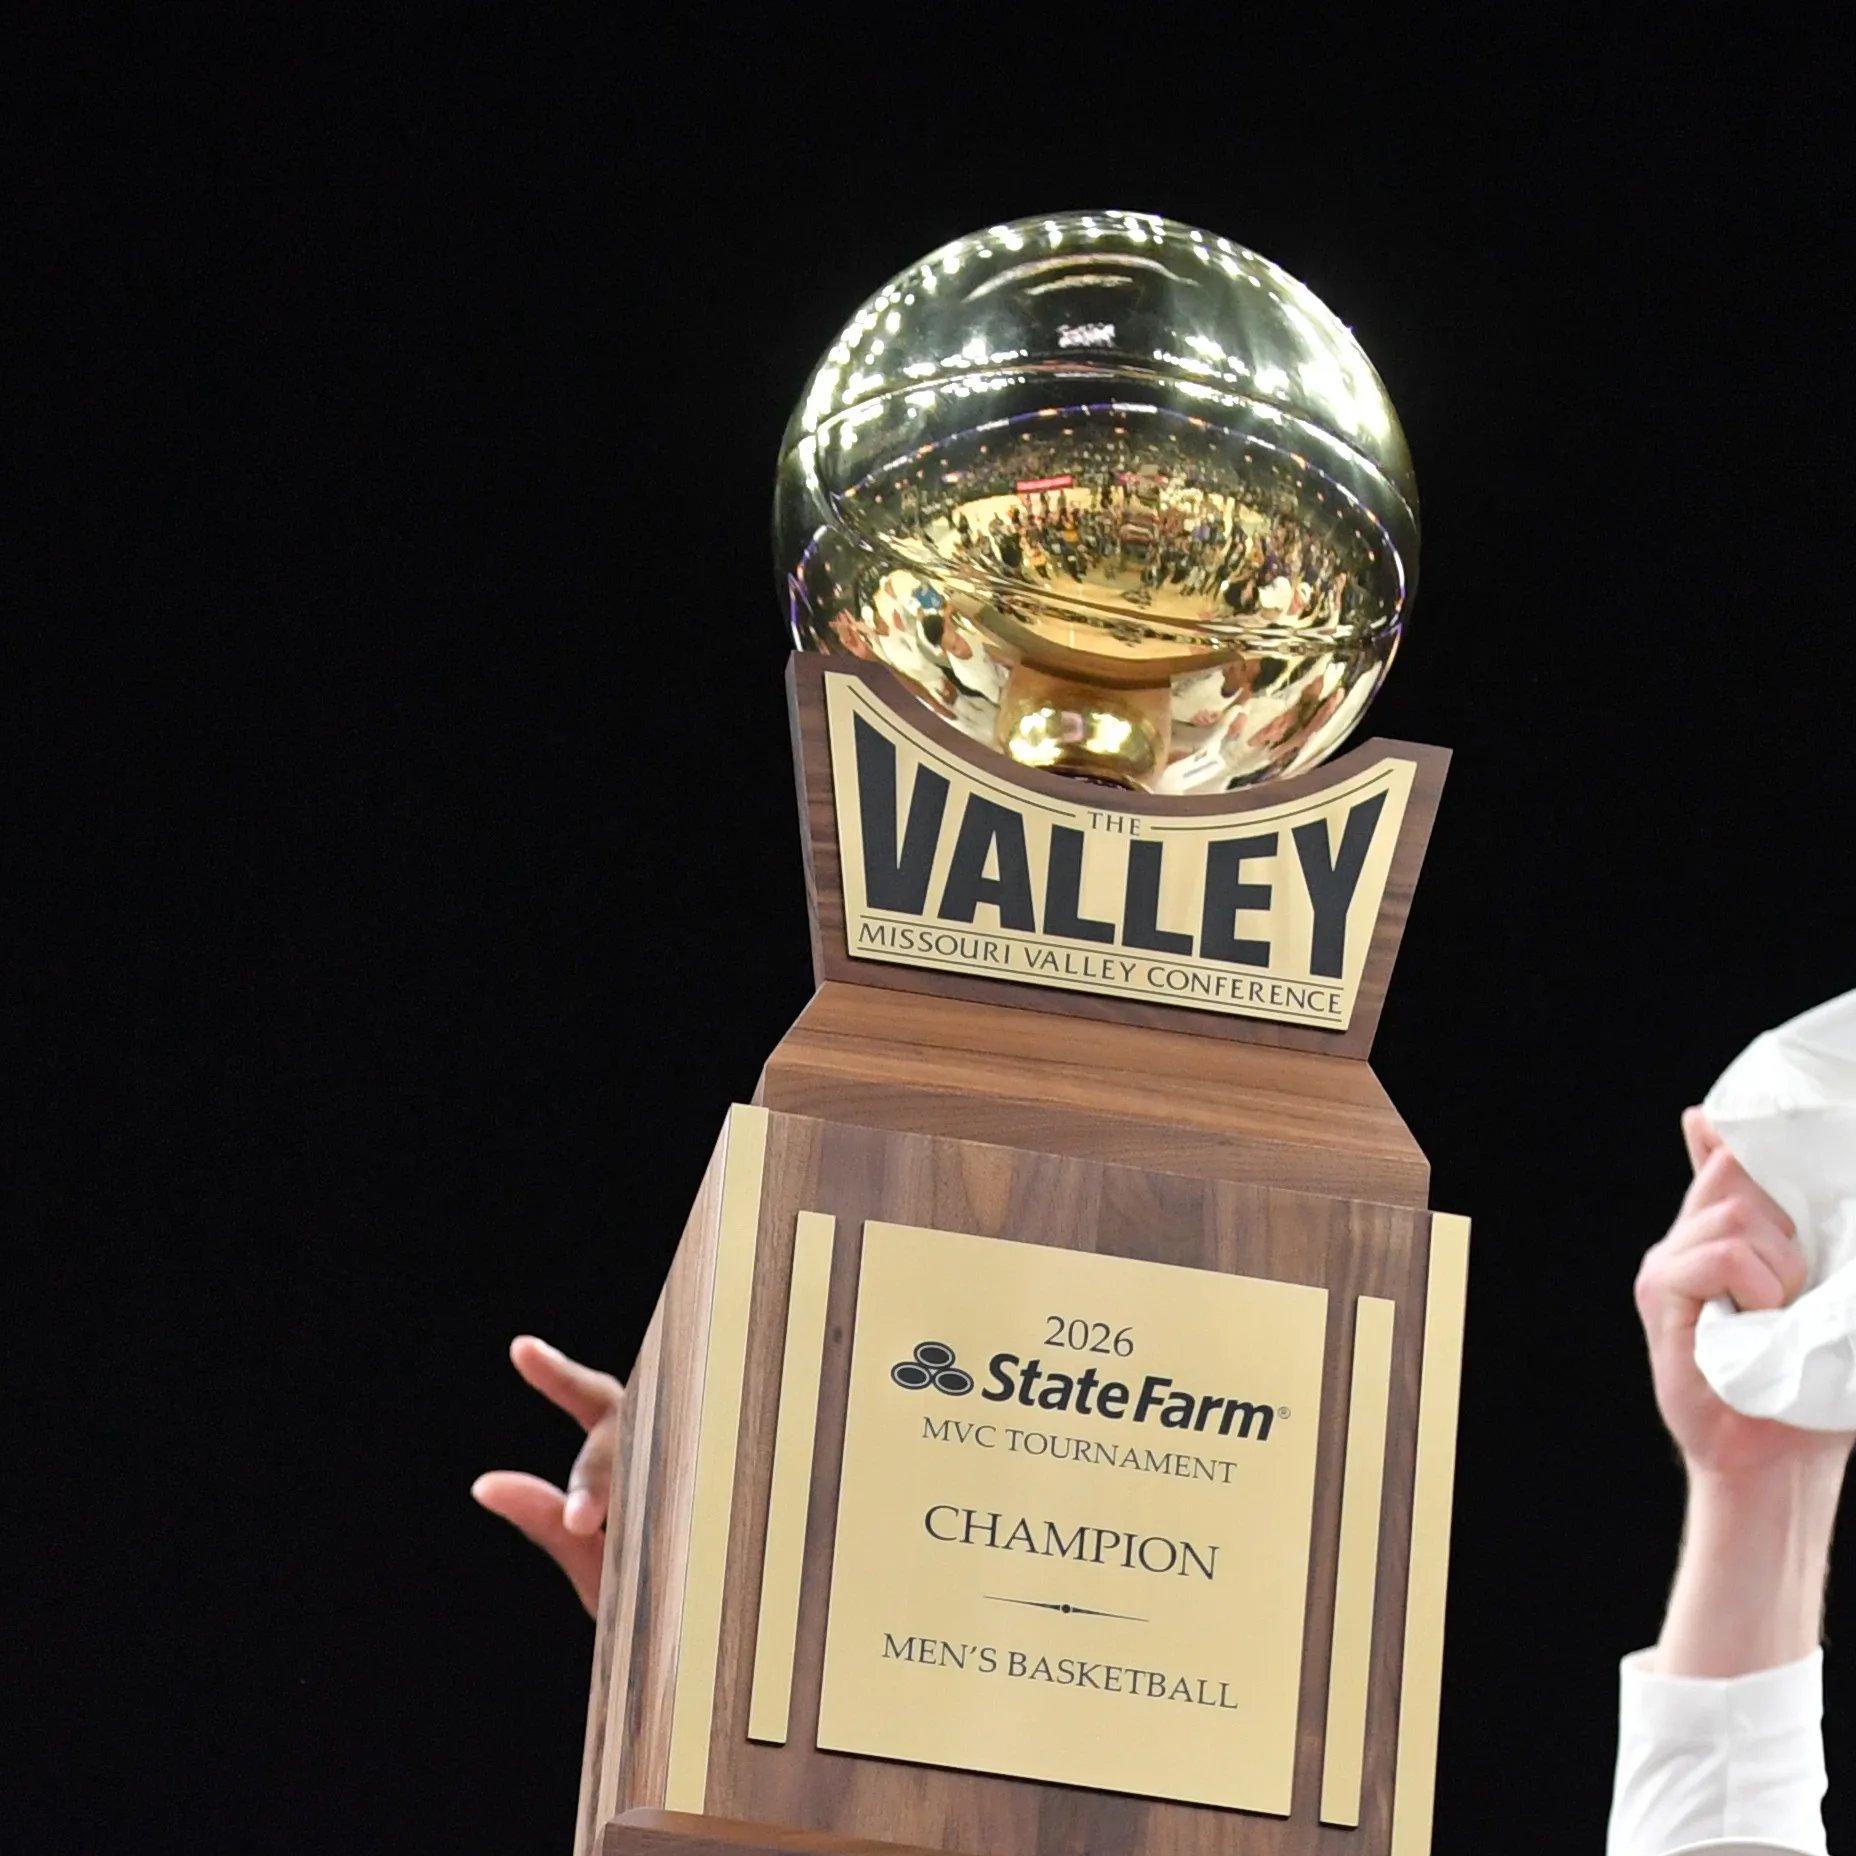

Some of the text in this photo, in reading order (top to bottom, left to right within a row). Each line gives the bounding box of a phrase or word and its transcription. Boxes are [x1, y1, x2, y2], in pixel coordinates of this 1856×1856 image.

[852, 709, 1389, 980] VALLEY
[1087, 811, 1142, 837] THE
[858, 922, 1343, 1016] MISSOURI VALLEY CONFERENCE
[1043, 1315, 1135, 1358] 2026
[922, 1416, 1238, 1484] MVC TOURNAMENT
[924, 1504, 1220, 1580] CHAMPION
[881, 1632, 1240, 1709] MEN'S BASKETBALL
